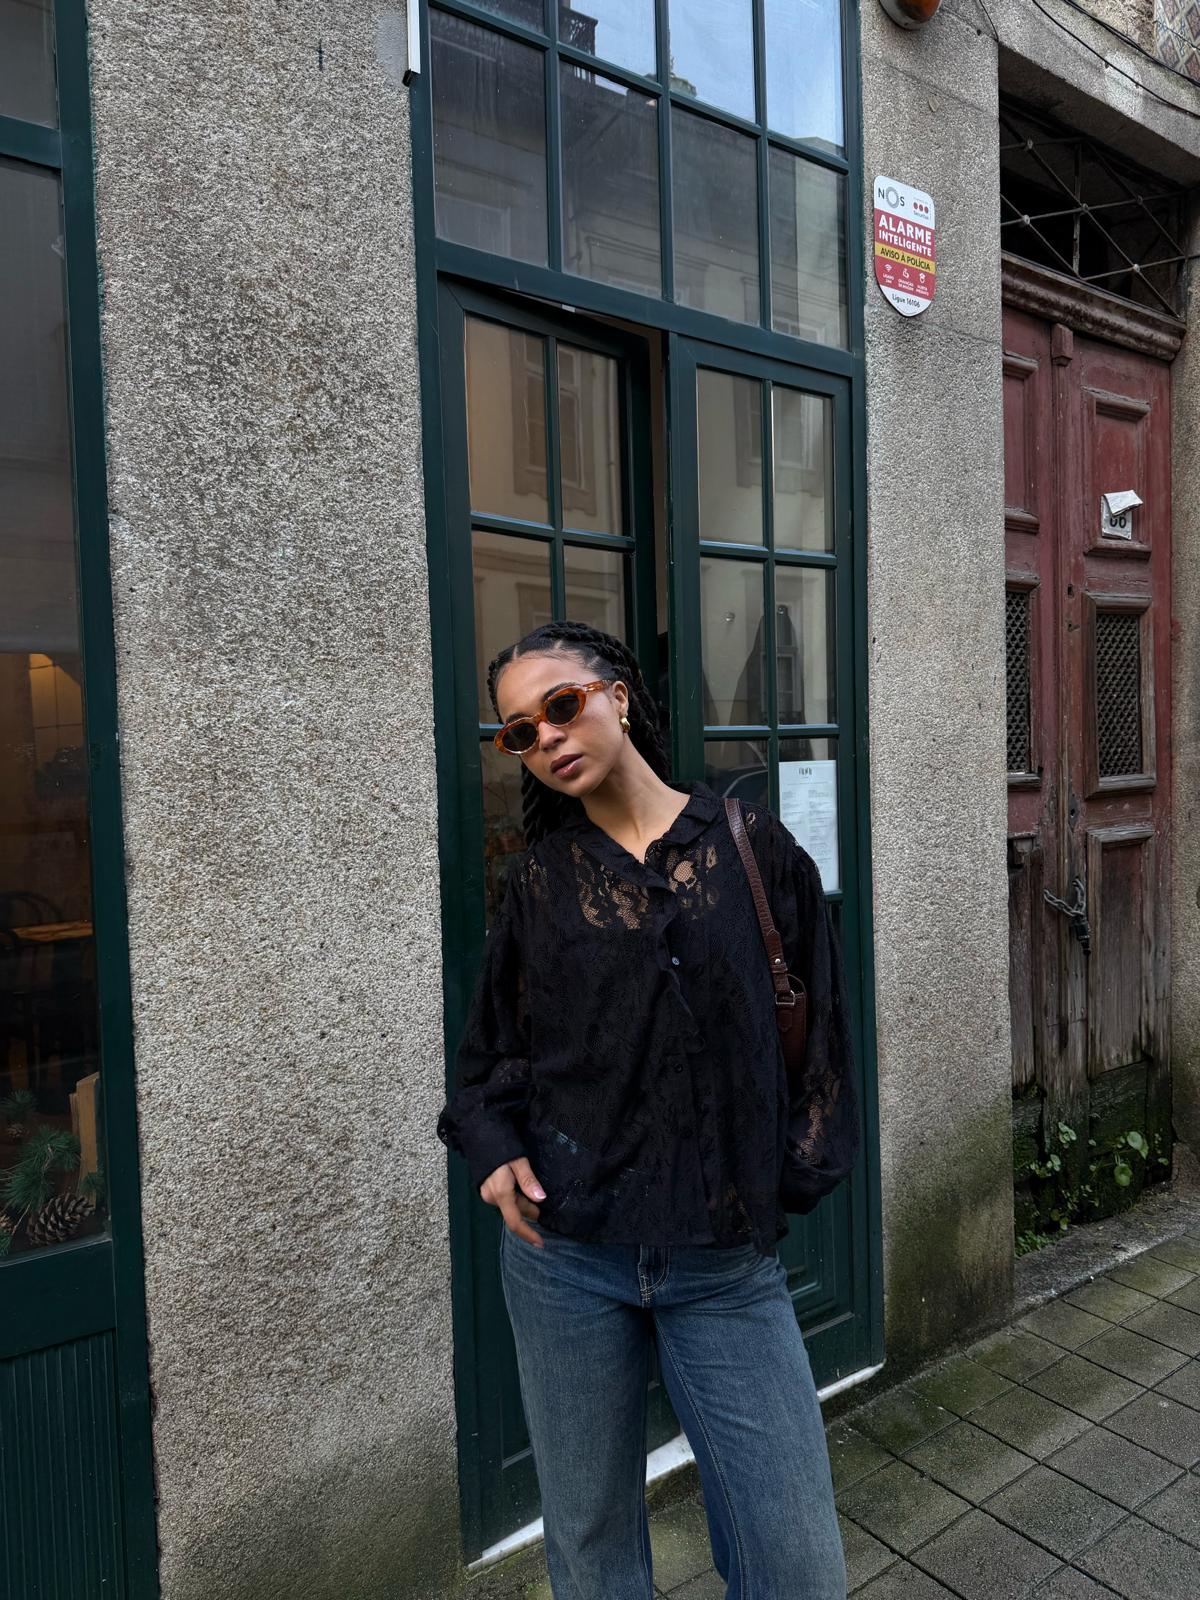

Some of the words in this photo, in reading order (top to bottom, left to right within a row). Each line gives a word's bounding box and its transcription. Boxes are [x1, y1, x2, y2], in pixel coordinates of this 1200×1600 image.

[878, 187, 905, 208] NOS
[879, 215, 931, 245] ALARME
[879, 230, 932, 257] INTELIGENTE
[880, 248, 900, 260] AVISO
[901, 252, 906, 262] À
[907, 256, 931, 271] POLÍCIA
